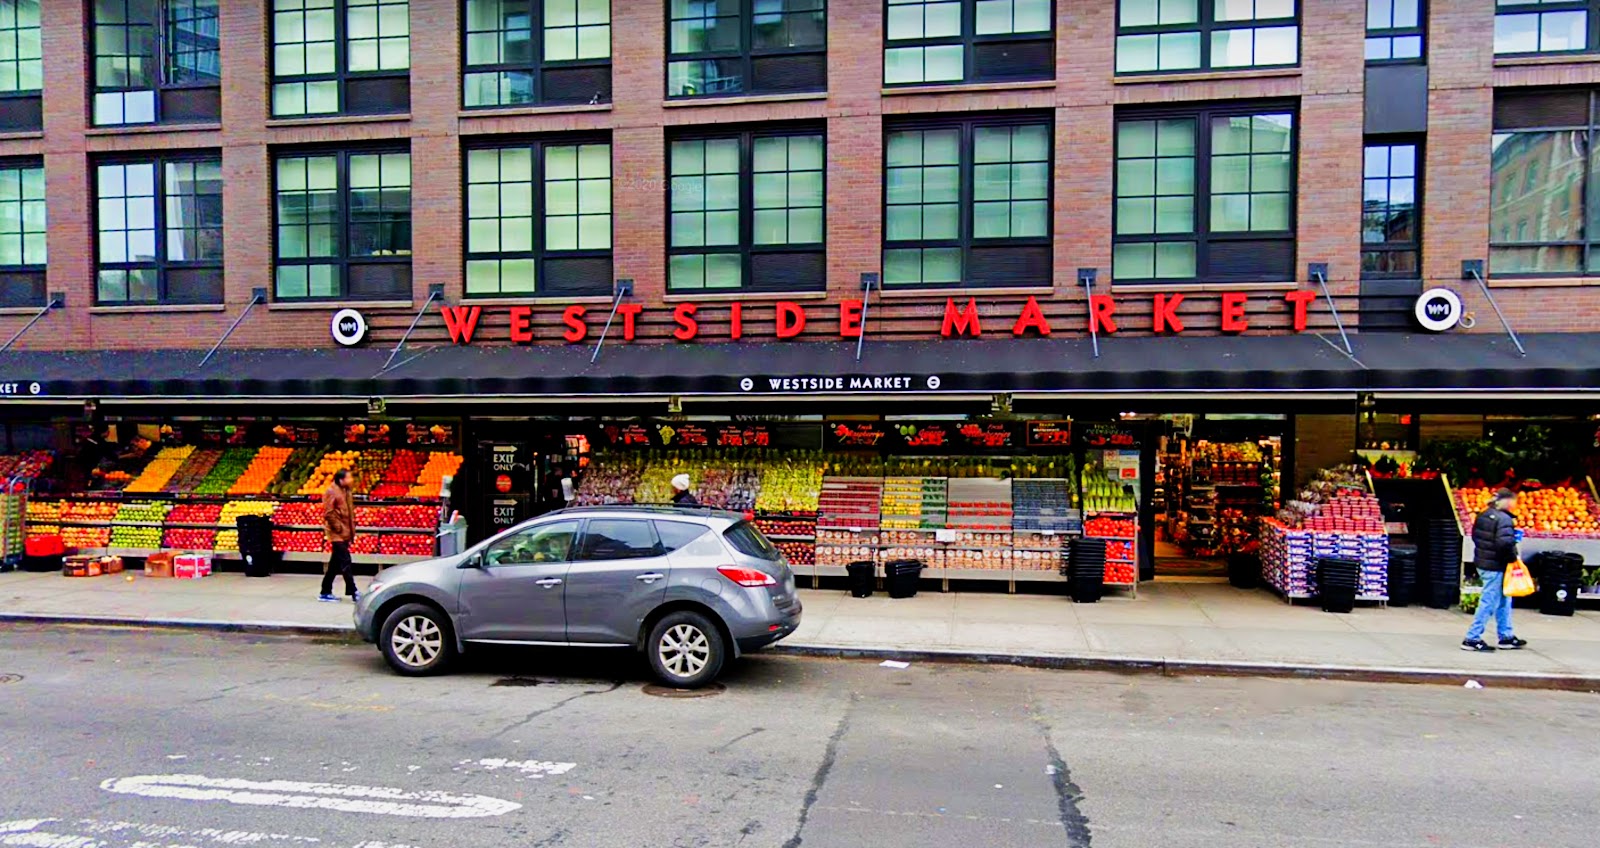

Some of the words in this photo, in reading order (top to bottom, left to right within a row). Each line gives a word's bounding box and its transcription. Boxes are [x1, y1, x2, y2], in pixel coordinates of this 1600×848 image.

[1427, 304, 1450, 315] WM
[441, 299, 865, 344] WESTSIDE
[940, 290, 1317, 338] MARKET
[340, 322, 357, 332] WM
[769, 378, 844, 389] WESTSIDE
[849, 377, 912, 389] MARKET
[493, 454, 515, 464] EXIT
[493, 507, 515, 517] EXIT
[493, 517, 515, 525] ONLY
